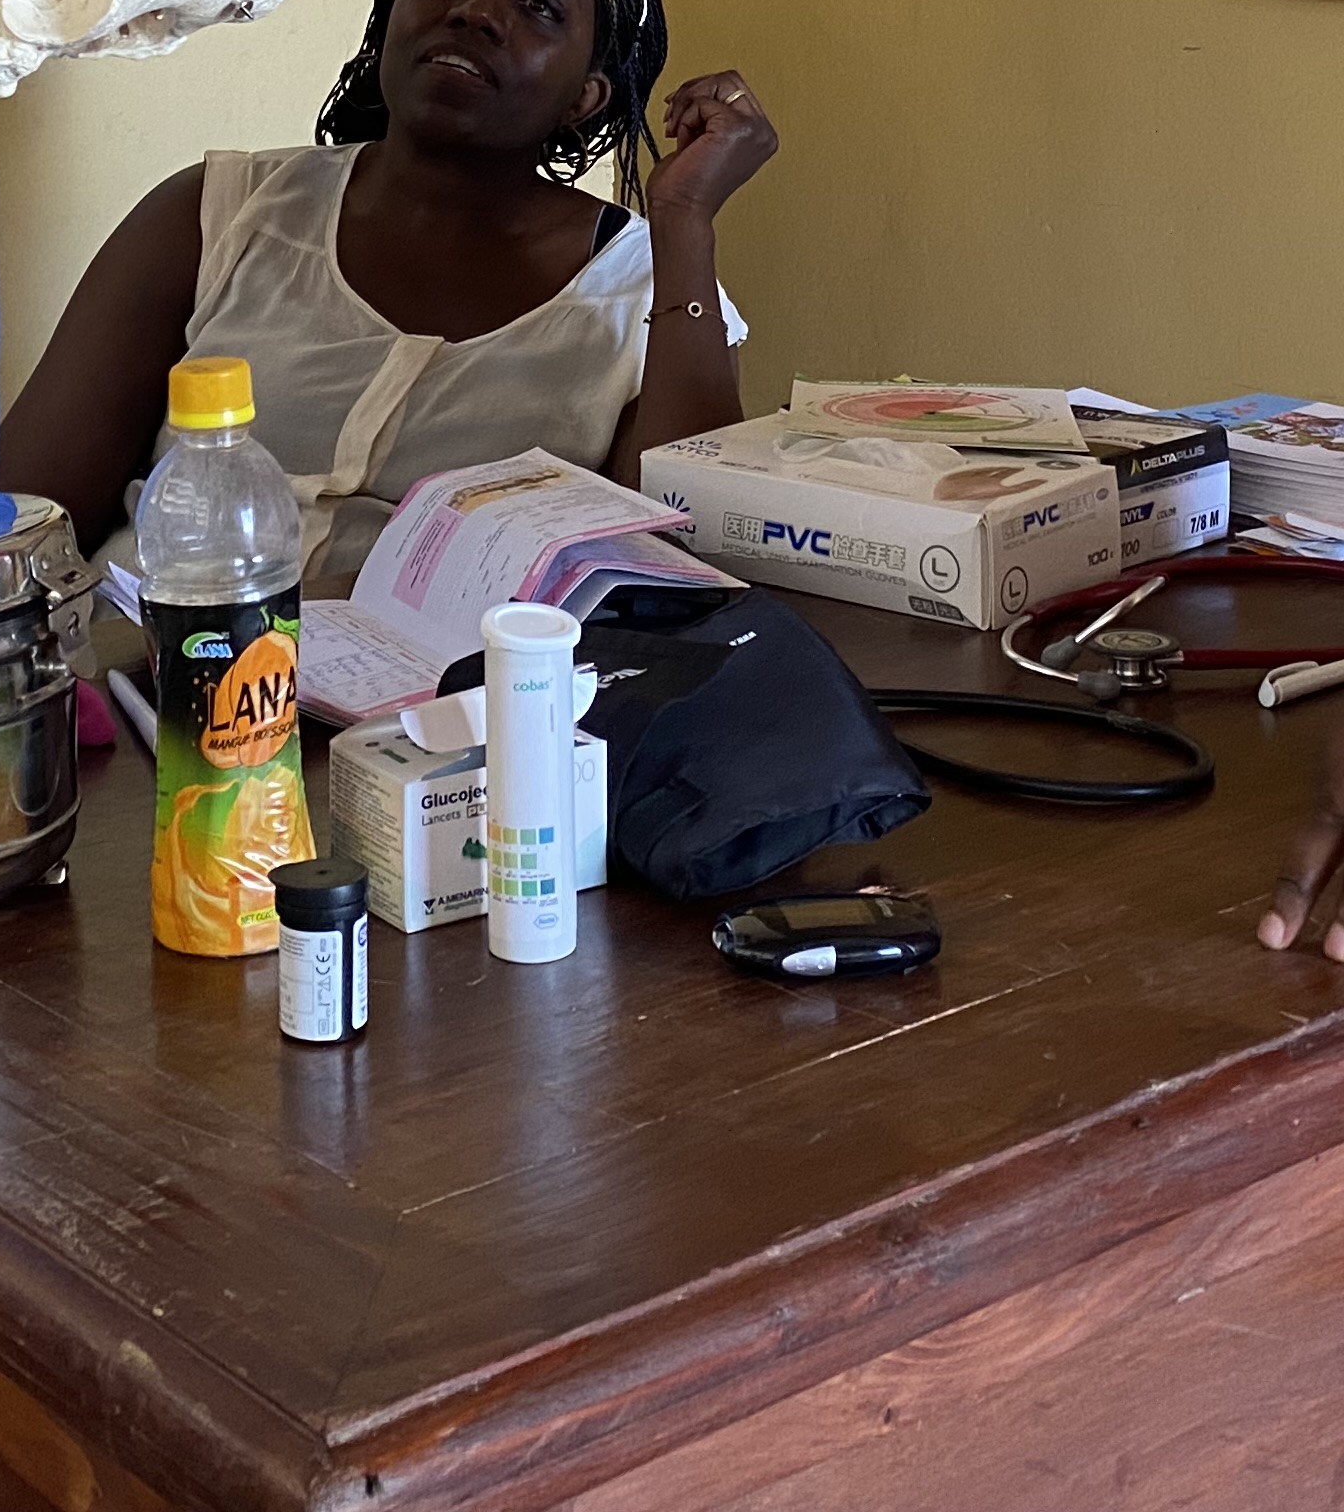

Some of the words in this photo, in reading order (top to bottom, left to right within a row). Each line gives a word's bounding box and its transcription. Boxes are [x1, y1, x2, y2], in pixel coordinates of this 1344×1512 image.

[1190, 514, 1207, 534] 7/8
[1209, 510, 1219, 527] M
[931, 557, 948, 577] L
[1009, 581, 1021, 598] L
[208, 665, 297, 732] LANA
[421, 809, 461, 826] Lancets
